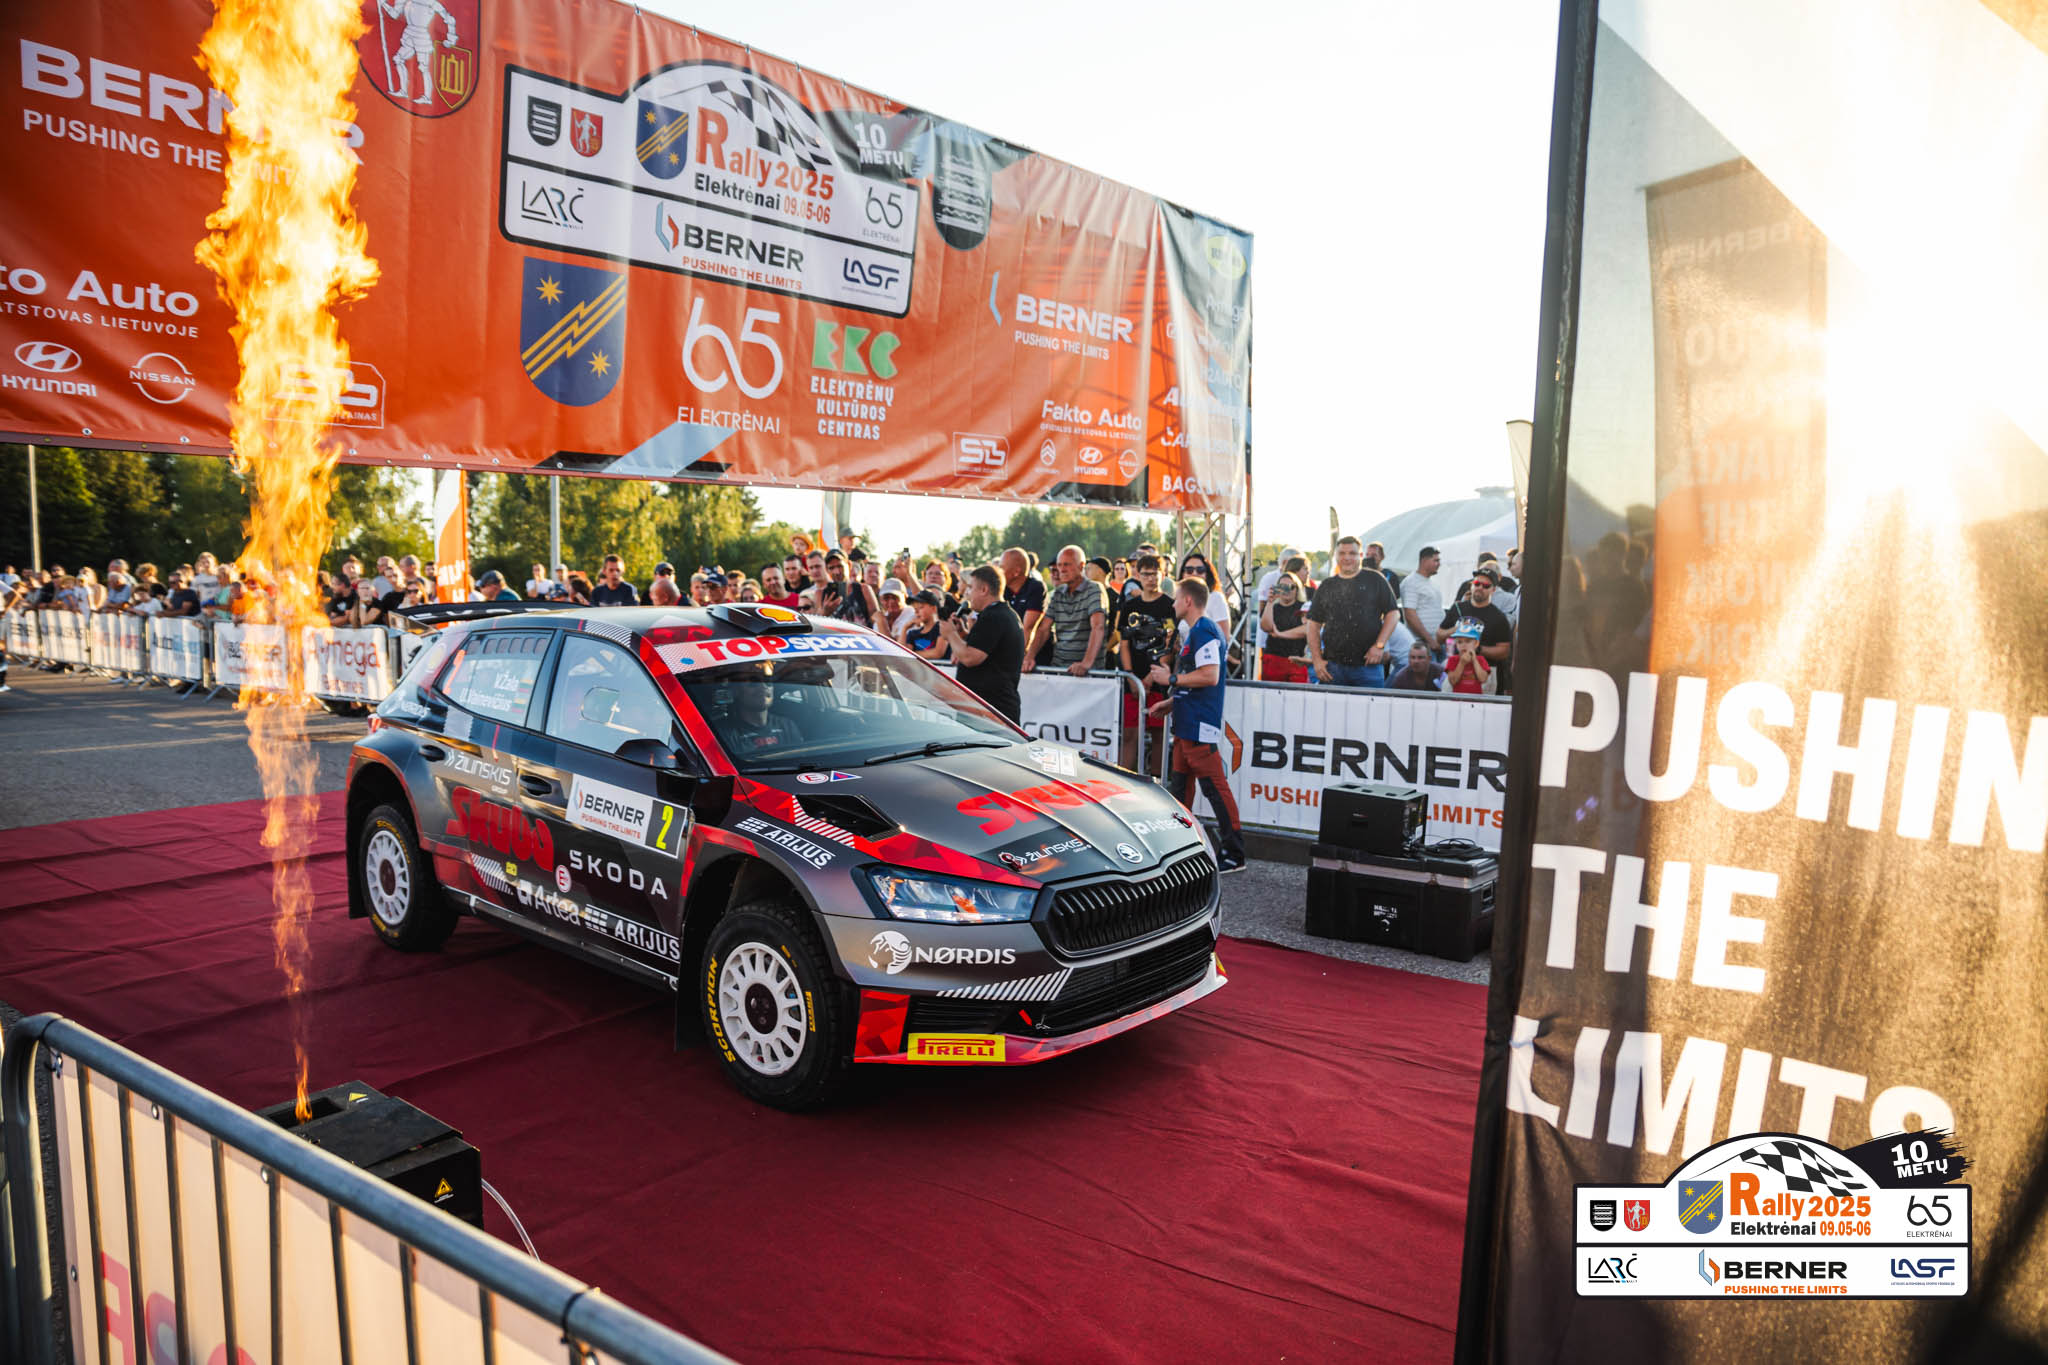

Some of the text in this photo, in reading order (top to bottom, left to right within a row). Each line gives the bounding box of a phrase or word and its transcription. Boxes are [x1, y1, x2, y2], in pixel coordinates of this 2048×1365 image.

[19, 38, 365, 166] BERNR
[23, 109, 160, 158] PUSHING
[168, 142, 222, 172] THE
[696, 106, 834, 200] Rally 2025
[854, 122, 887, 149] 10
[695, 173, 830, 224] Elektrėnai 09.05-06
[866, 187, 903, 228] 65
[684, 224, 803, 272] BERNER
[682, 256, 802, 290] PUSHING THE LIMITS
[66, 270, 199, 317] Auto
[101, 315, 199, 338] LIETUVOJE
[1016, 293, 1133, 343] BERNER
[682, 297, 783, 399] 65
[1015, 331, 1109, 360] PUSHING THE LIMITS
[1, 374, 97, 397] HYUNDAI
[129, 369, 196, 386] NISSAN
[811, 376, 894, 406] ELEKTRĖNŲ
[677, 406, 780, 433] ELEKTRĖNAI
[817, 399, 886, 421] KULTŪROS
[1042, 400, 1142, 430] Fakto Auto
[818, 420, 880, 440] CENTRAS
[1251, 731, 1507, 792] BERNER
[1539, 665, 2048, 854] PUSHIN
[584, 793, 674, 850] BERNER 2
[608, 822, 619, 832] THE
[1427, 803, 1504, 828] IMITS
[765, 830, 832, 866] ARIJUS
[1029, 838, 1083, 862] ŽILINSKIS
[535, 885, 581, 927] Artea
[1532, 844, 1778, 993] THE
[614, 919, 680, 960] ARIJUS
[915, 946, 1016, 965] NØRDIS
[707, 955, 736, 1063] SCORPION
[918, 1038, 996, 1056] PIRELLI
